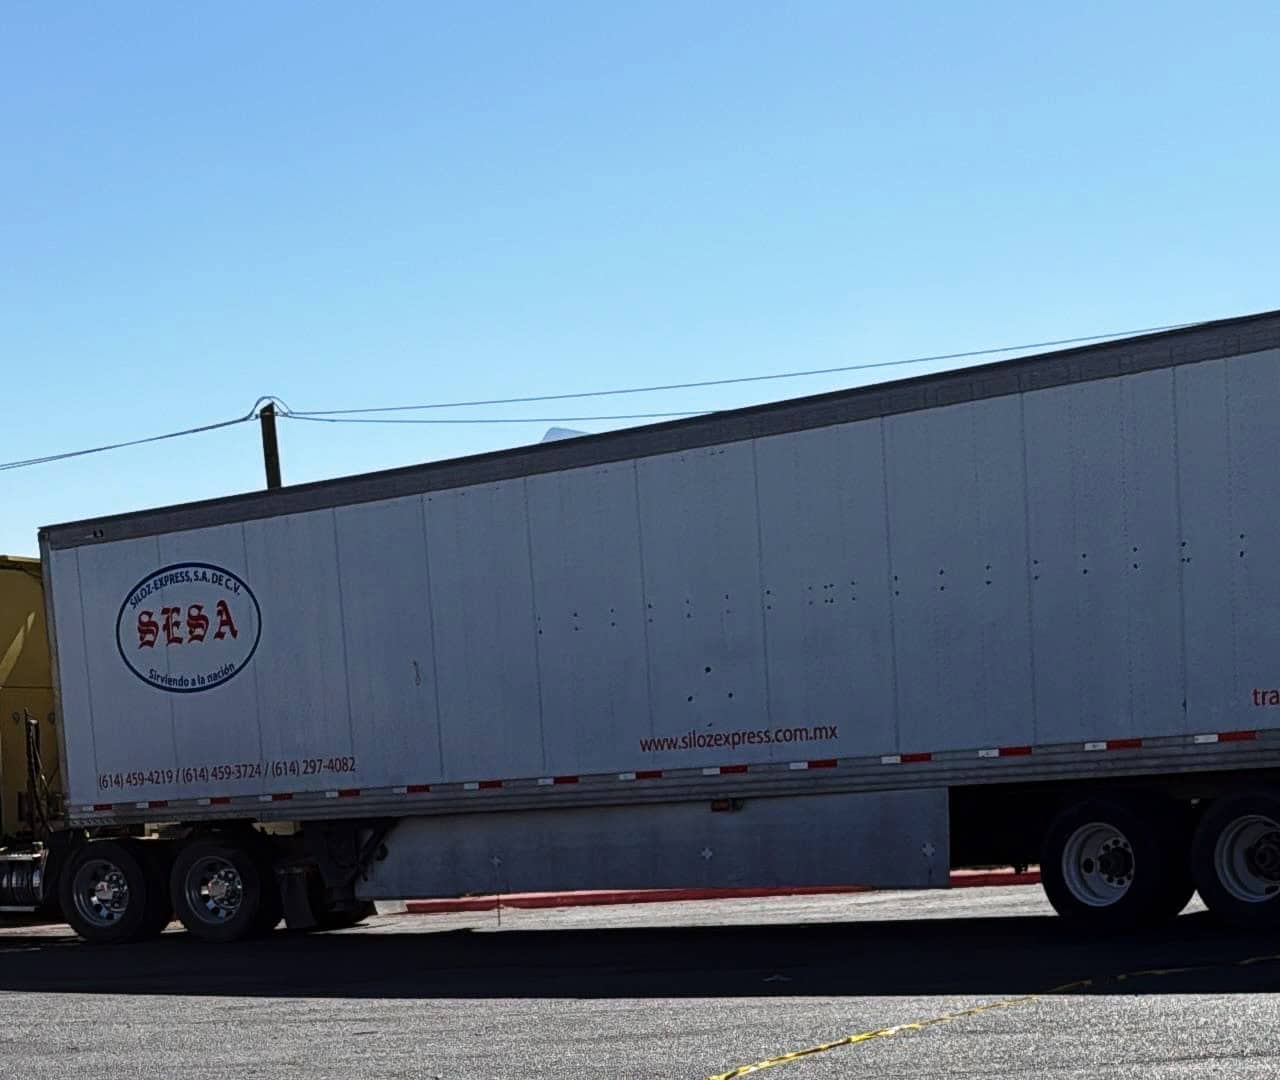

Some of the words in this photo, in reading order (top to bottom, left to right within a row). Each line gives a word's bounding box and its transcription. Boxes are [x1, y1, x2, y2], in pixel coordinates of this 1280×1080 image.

[211, 572, 223, 586] DE
[224, 577, 240, 596] C.V.
[137, 599, 239, 650] SESA
[148, 668, 189, 687] Sirviendo
[197, 674, 206, 685] la
[639, 724, 839, 753] www.silozexpress.com.mx
[99, 773, 124, 791] (614)
[125, 769, 174, 787] 459-4219
[182, 766, 209, 785] (614)
[210, 763, 262, 781] 459-3724
[272, 760, 300, 779] (614)
[302, 756, 356, 775] 297-4082
